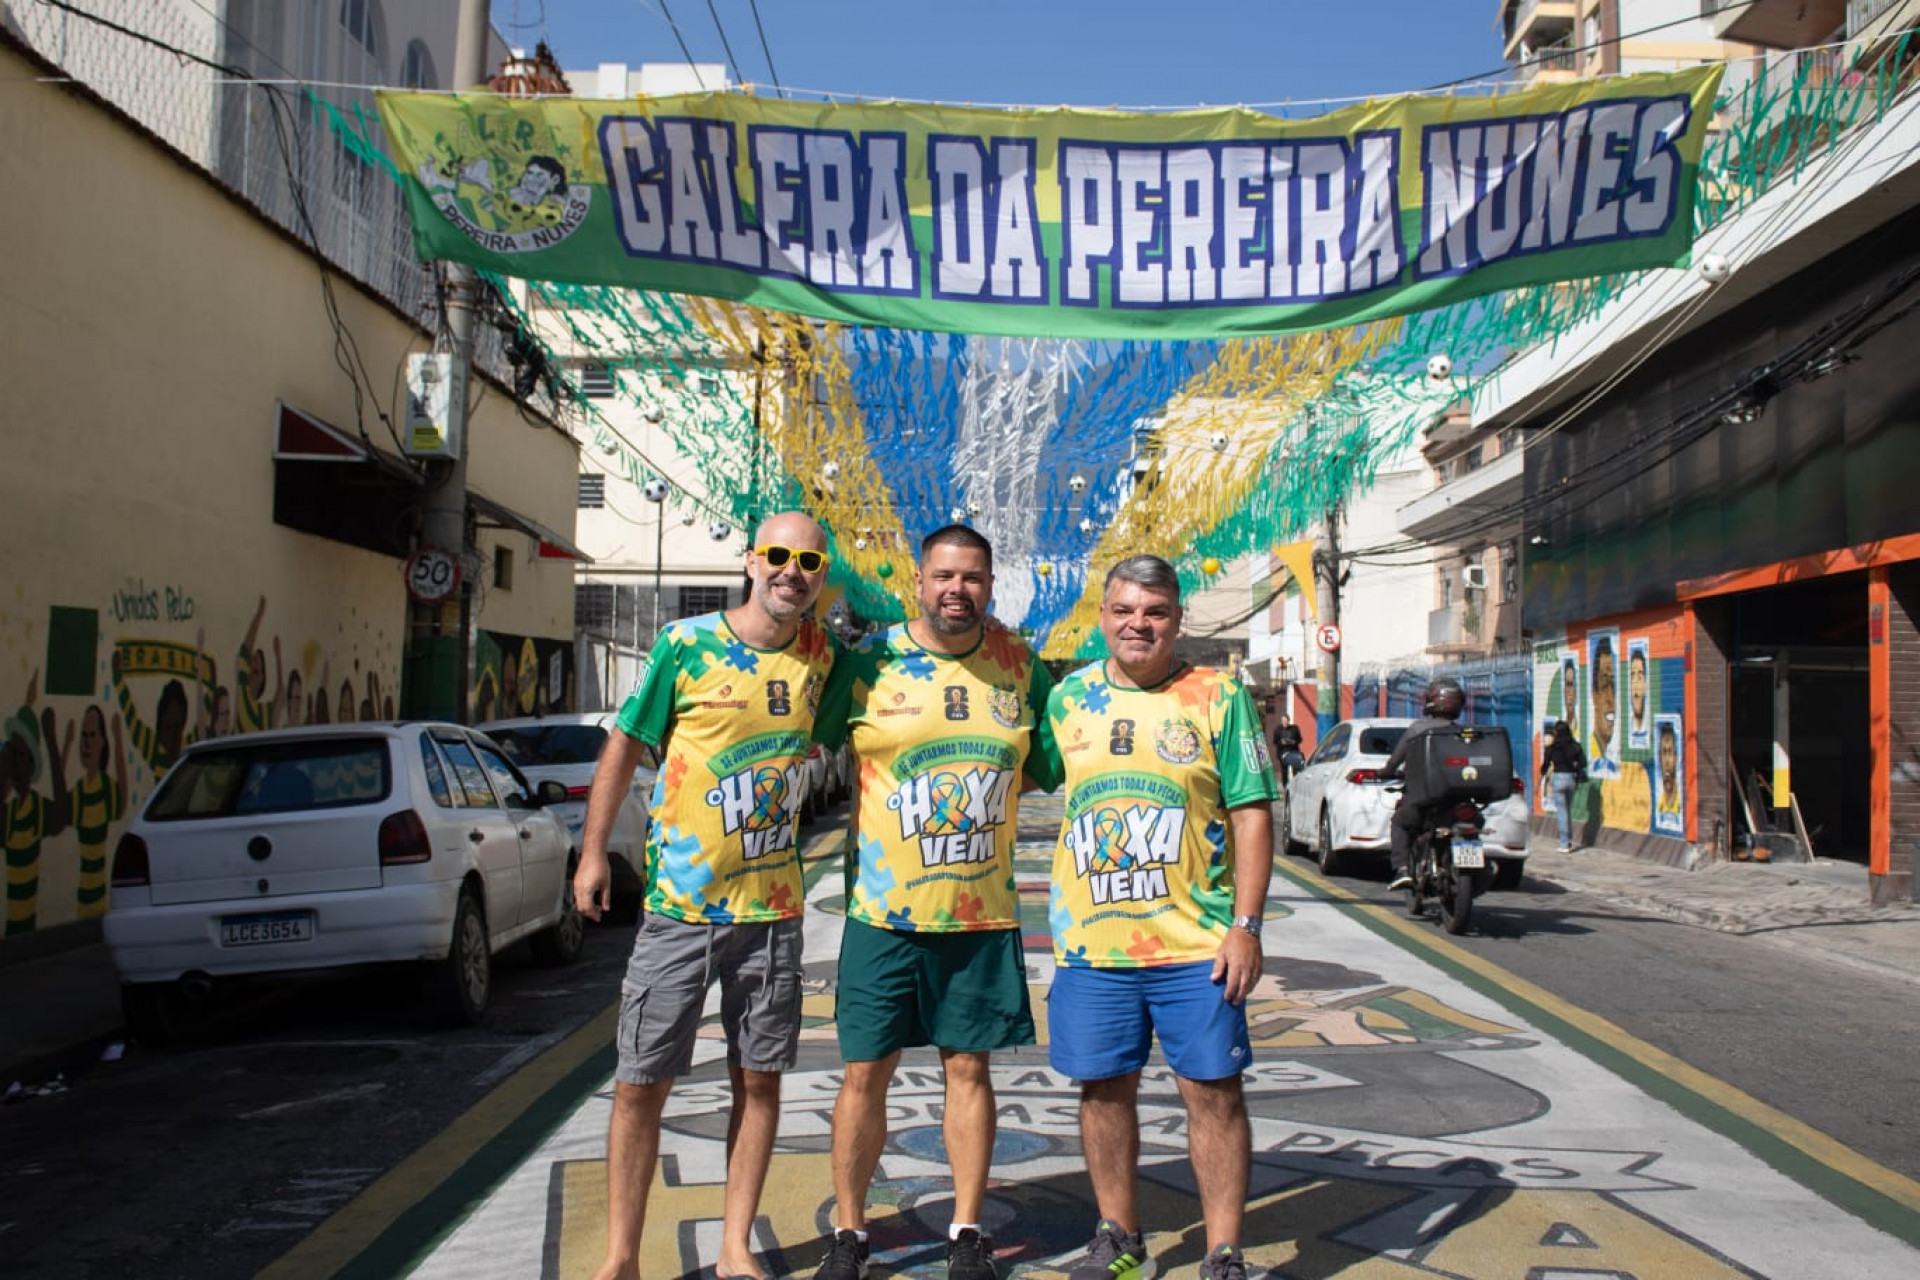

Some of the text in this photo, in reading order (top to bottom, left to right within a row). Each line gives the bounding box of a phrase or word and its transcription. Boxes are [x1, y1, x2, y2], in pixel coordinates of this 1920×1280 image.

[600, 93, 1692, 310] GALERA DA PEREIRA NUNES
[443, 199, 587, 250] PEREIRA NUNES
[414, 554, 450, 585] 50
[122, 645, 199, 673] BRASIL
[1120, 776, 1146, 791] TODAS
[919, 827, 997, 868] VEM
[1088, 866, 1170, 906] VEM
[229, 920, 301, 943] LCE3G54
